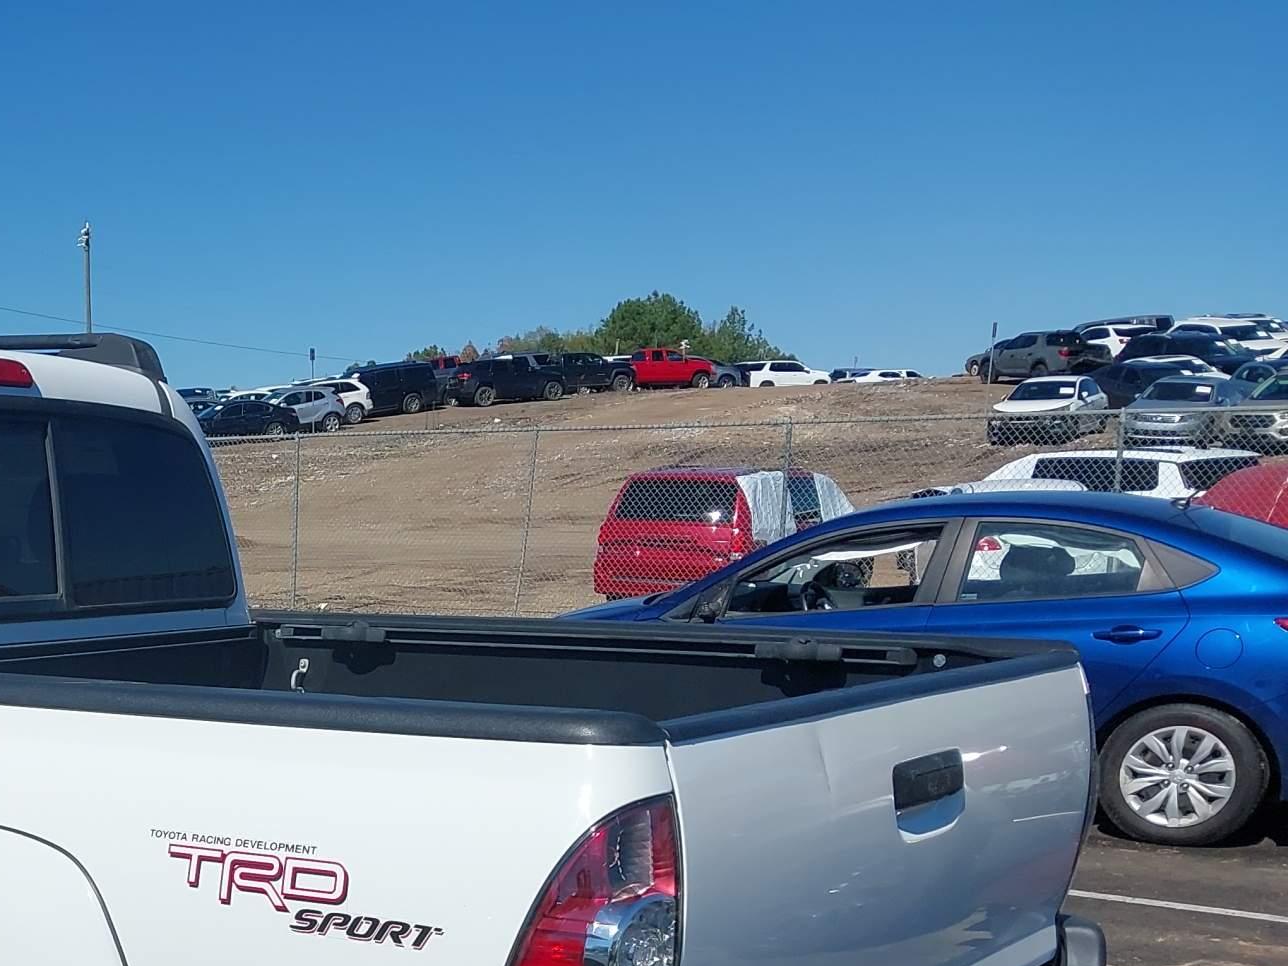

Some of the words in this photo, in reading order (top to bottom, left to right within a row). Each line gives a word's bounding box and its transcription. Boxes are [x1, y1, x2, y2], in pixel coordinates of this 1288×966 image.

[150, 829, 187, 842] TOYOTA
[191, 834, 231, 847] RACING
[235, 839, 318, 855] DEVELOPMENT
[168, 844, 349, 912] TRD
[289, 909, 433, 950] SPORT
